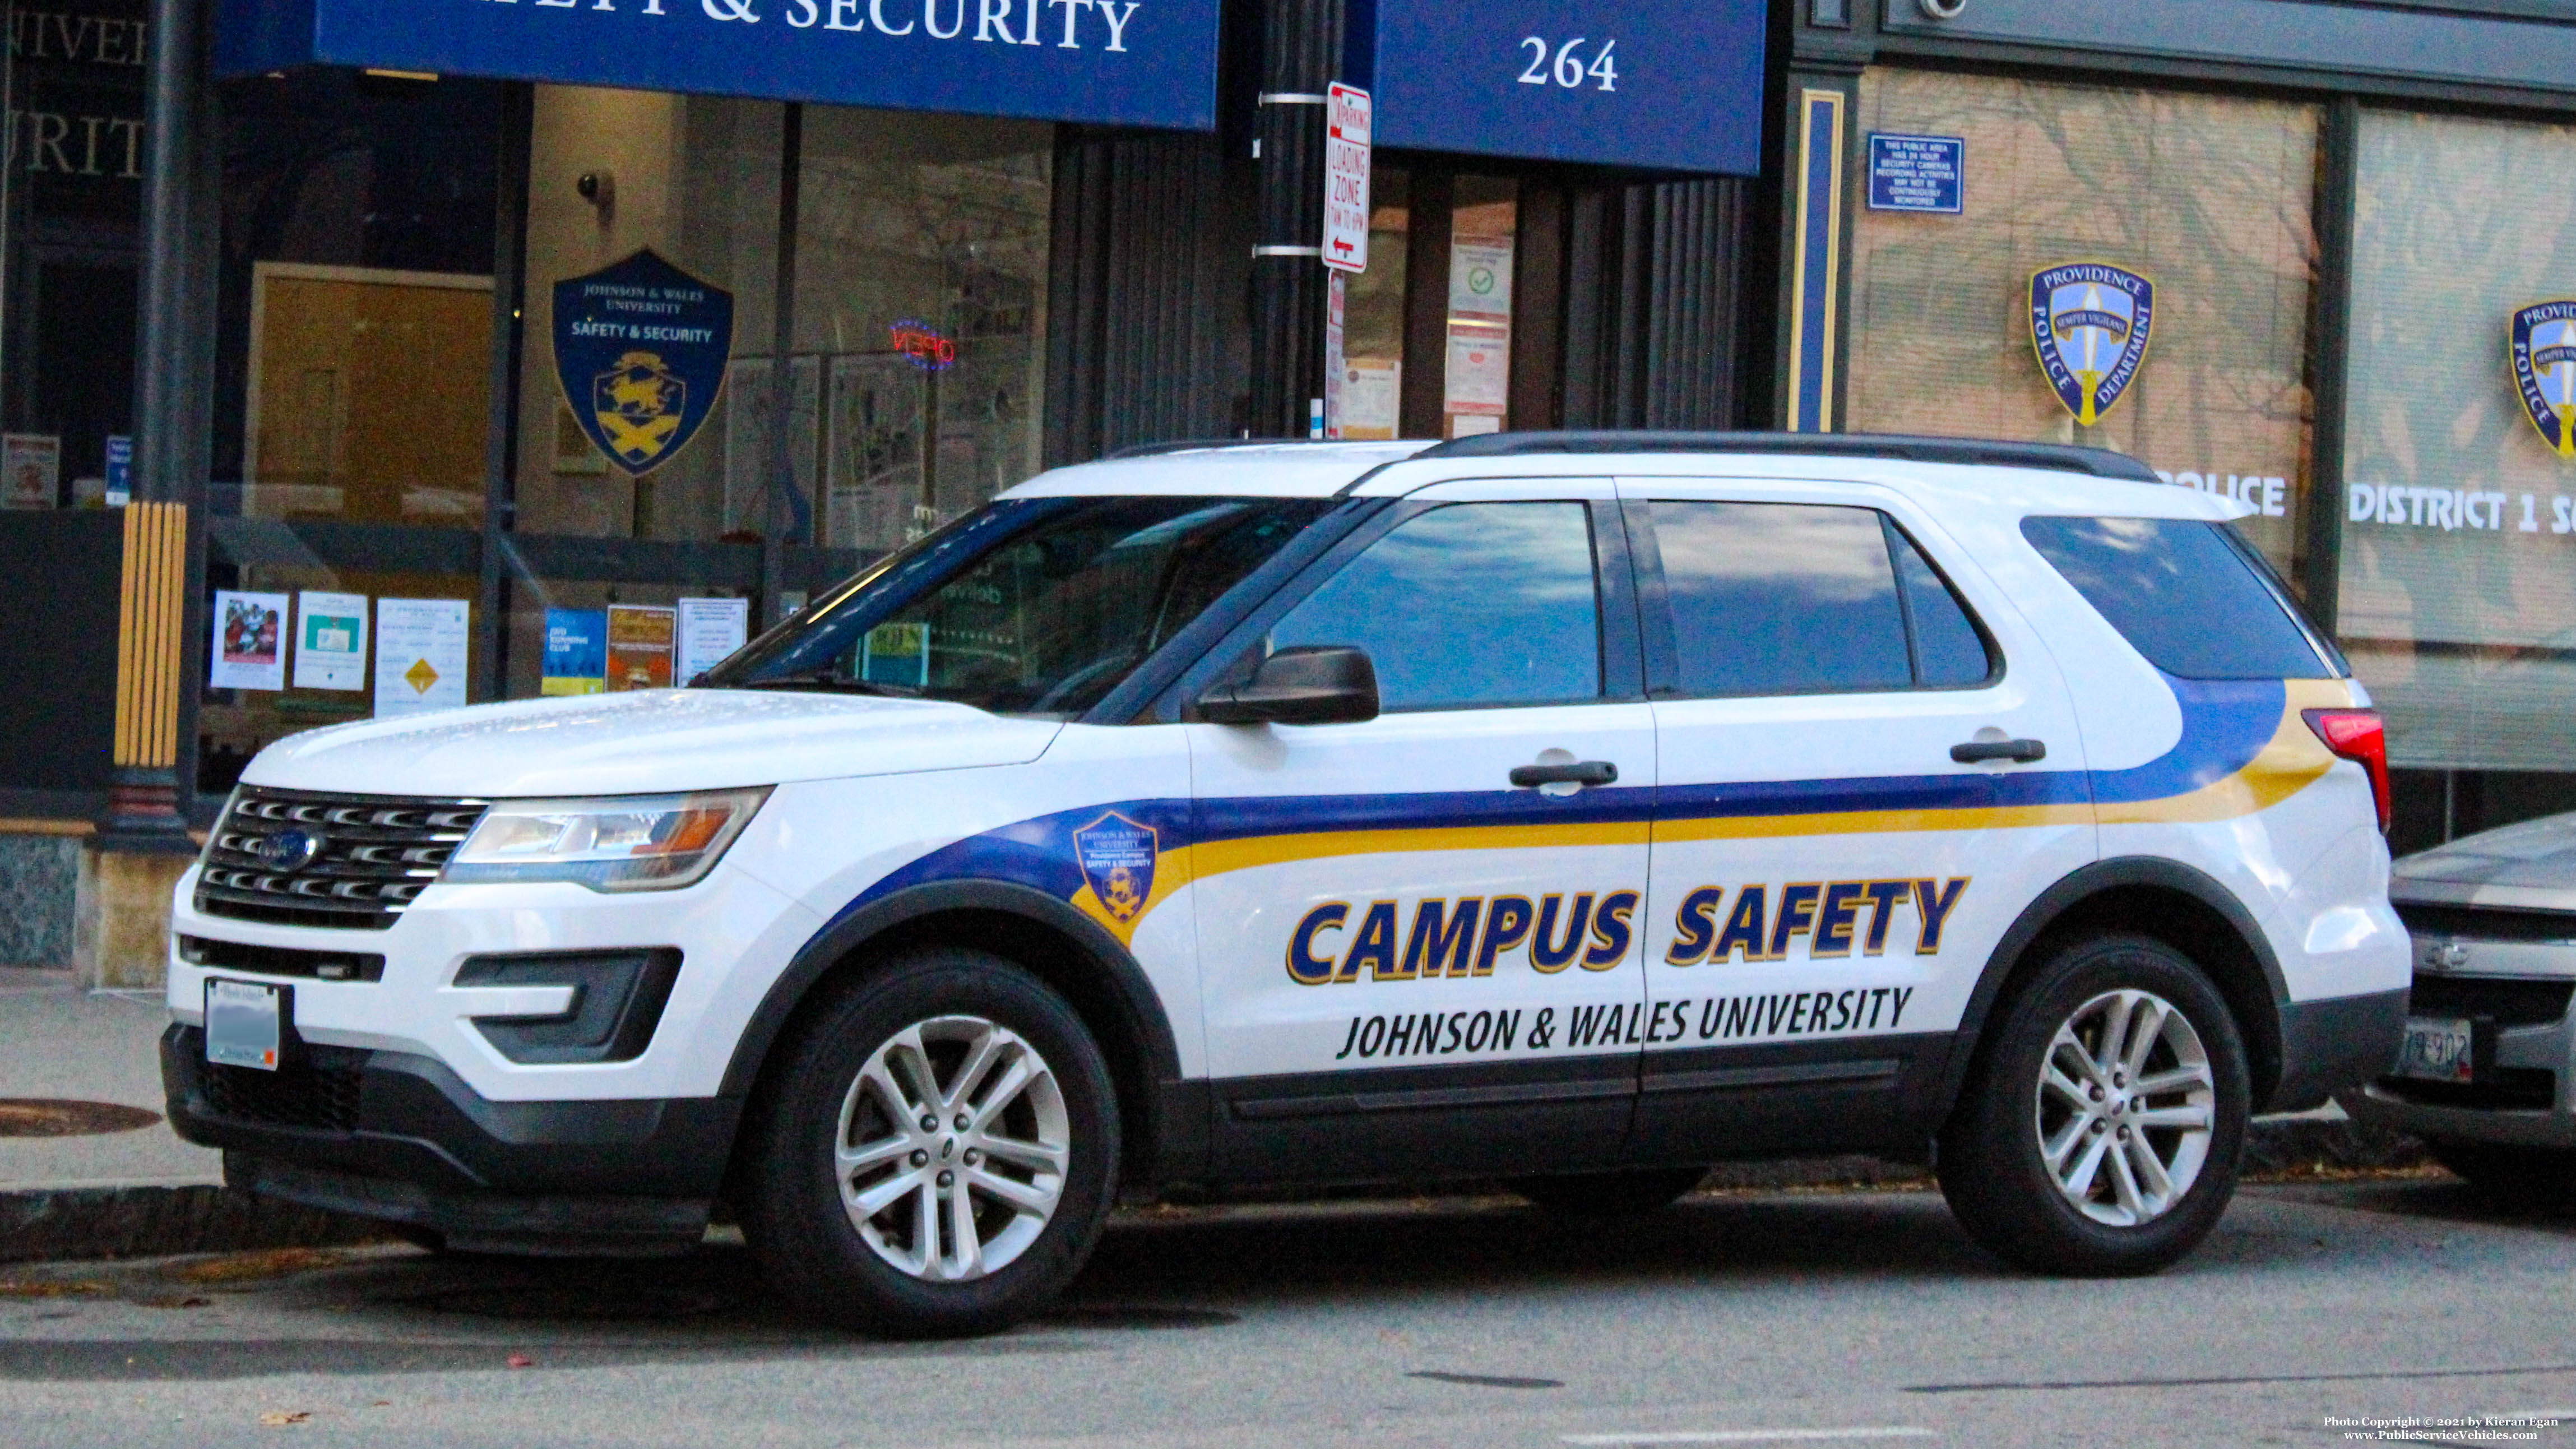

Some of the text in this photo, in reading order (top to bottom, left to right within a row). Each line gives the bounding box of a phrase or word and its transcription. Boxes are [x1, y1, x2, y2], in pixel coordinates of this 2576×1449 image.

[786, 0, 1140, 52] SECURITY
[1518, 37, 1618, 91] 264
[1332, 143, 1364, 176] LOADING
[1892, 151, 1907, 159] HAS
[1920, 152, 1940, 161] HOUR
[1902, 142, 1928, 151] PUBLIC
[1877, 168, 1955, 180] RECORDING ACTIVITIES
[1880, 159, 1950, 170] SECURITY CAMERAS
[1335, 175, 1360, 206] ZONE
[1888, 186, 1941, 197] CONTINUOUSLY
[1911, 178, 1925, 187] NOT
[585, 284, 705, 302] JOHNSON & WALES
[2044, 266, 2143, 296] PROVIDENCE
[606, 299, 682, 314] UNIVERSITY
[571, 321, 713, 343] SAFETY & SECURITY
[2034, 307, 2070, 390] POLICE
[2098, 303, 2150, 404] DEPARTMENT
[2514, 343, 2550, 423] POLICE
[2348, 484, 2507, 531] DISTRICT
[2519, 494, 2538, 532] 1
[2551, 495, 2576, 534] S
[1094, 840, 1138, 849] UNIVERSITY
[1087, 860, 1111, 869] SAFETY
[1119, 859, 1151, 868] SECURITY
[1286, 876, 1972, 985] CAMPUS SAFETY
[1336, 987, 1914, 1059] JOHNSON & WALES UNIVERSITY
